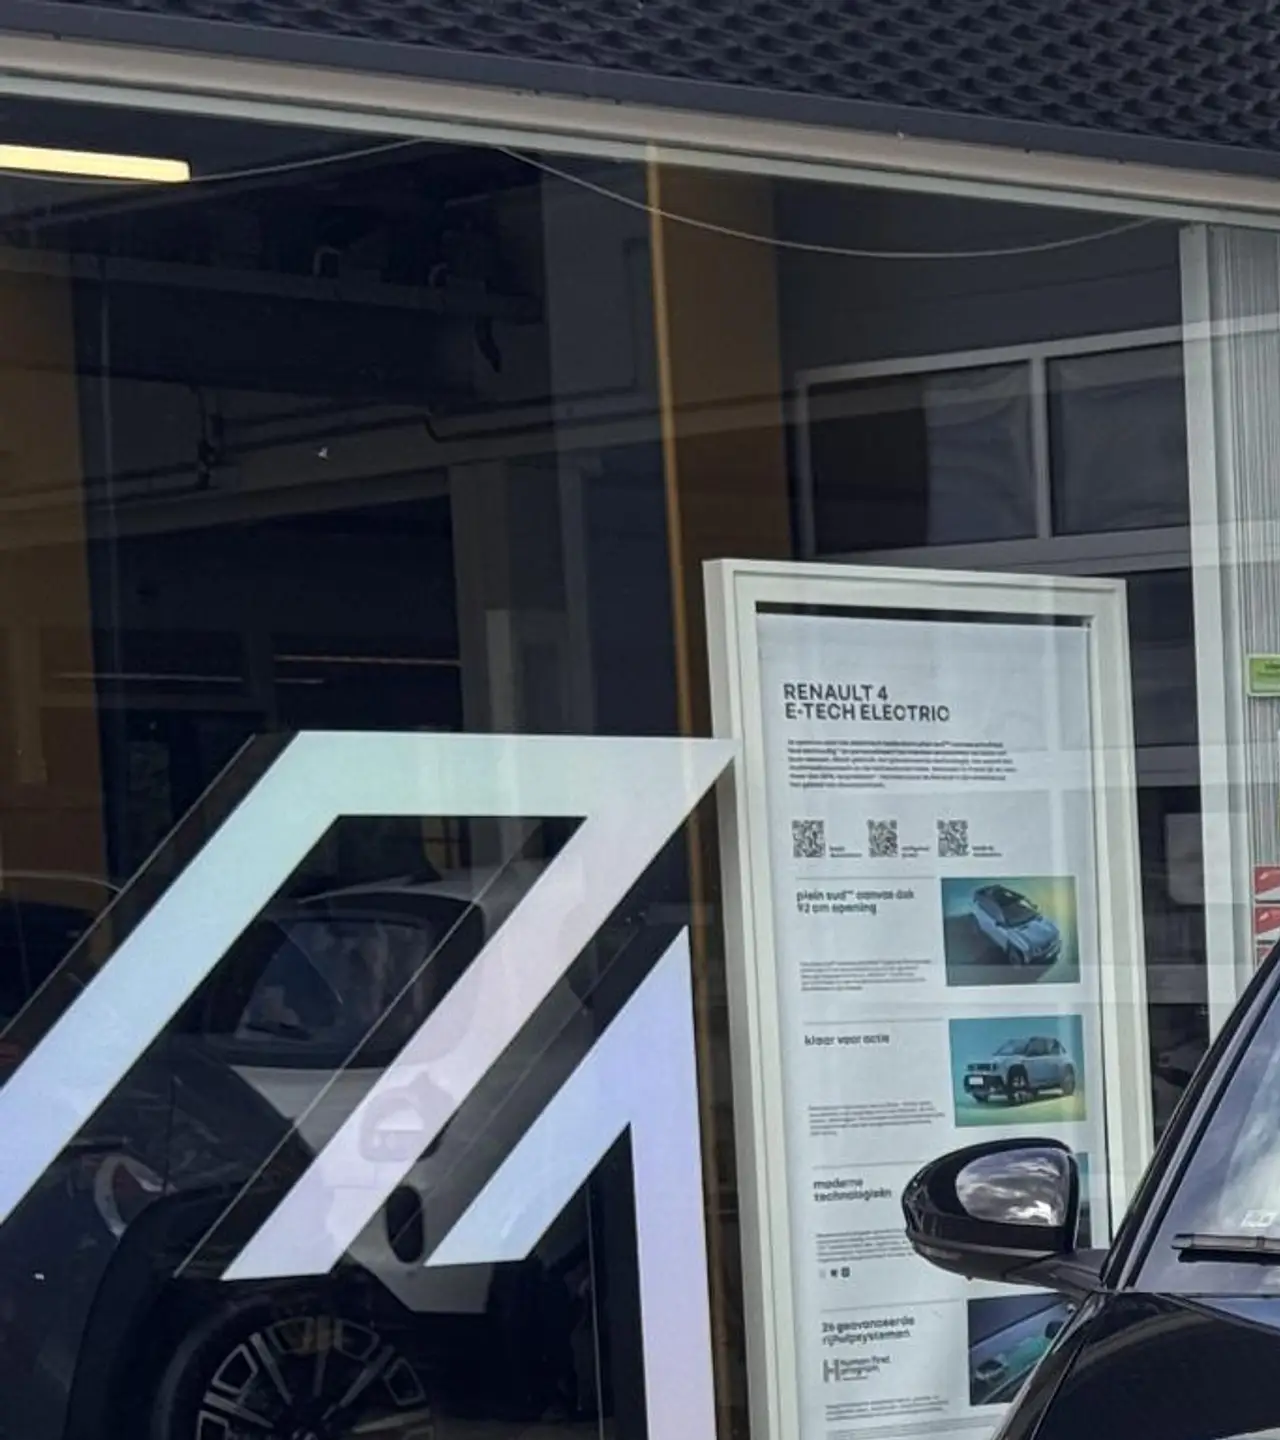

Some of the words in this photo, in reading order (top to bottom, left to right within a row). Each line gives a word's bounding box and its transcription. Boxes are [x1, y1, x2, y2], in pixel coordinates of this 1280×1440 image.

[783, 683, 873, 701] RENAULT
[877, 685, 889, 701] 4
[785, 702, 856, 720] E-TECH
[860, 704, 950, 722] ELECTRIC
[832, 902, 877, 915] opening
